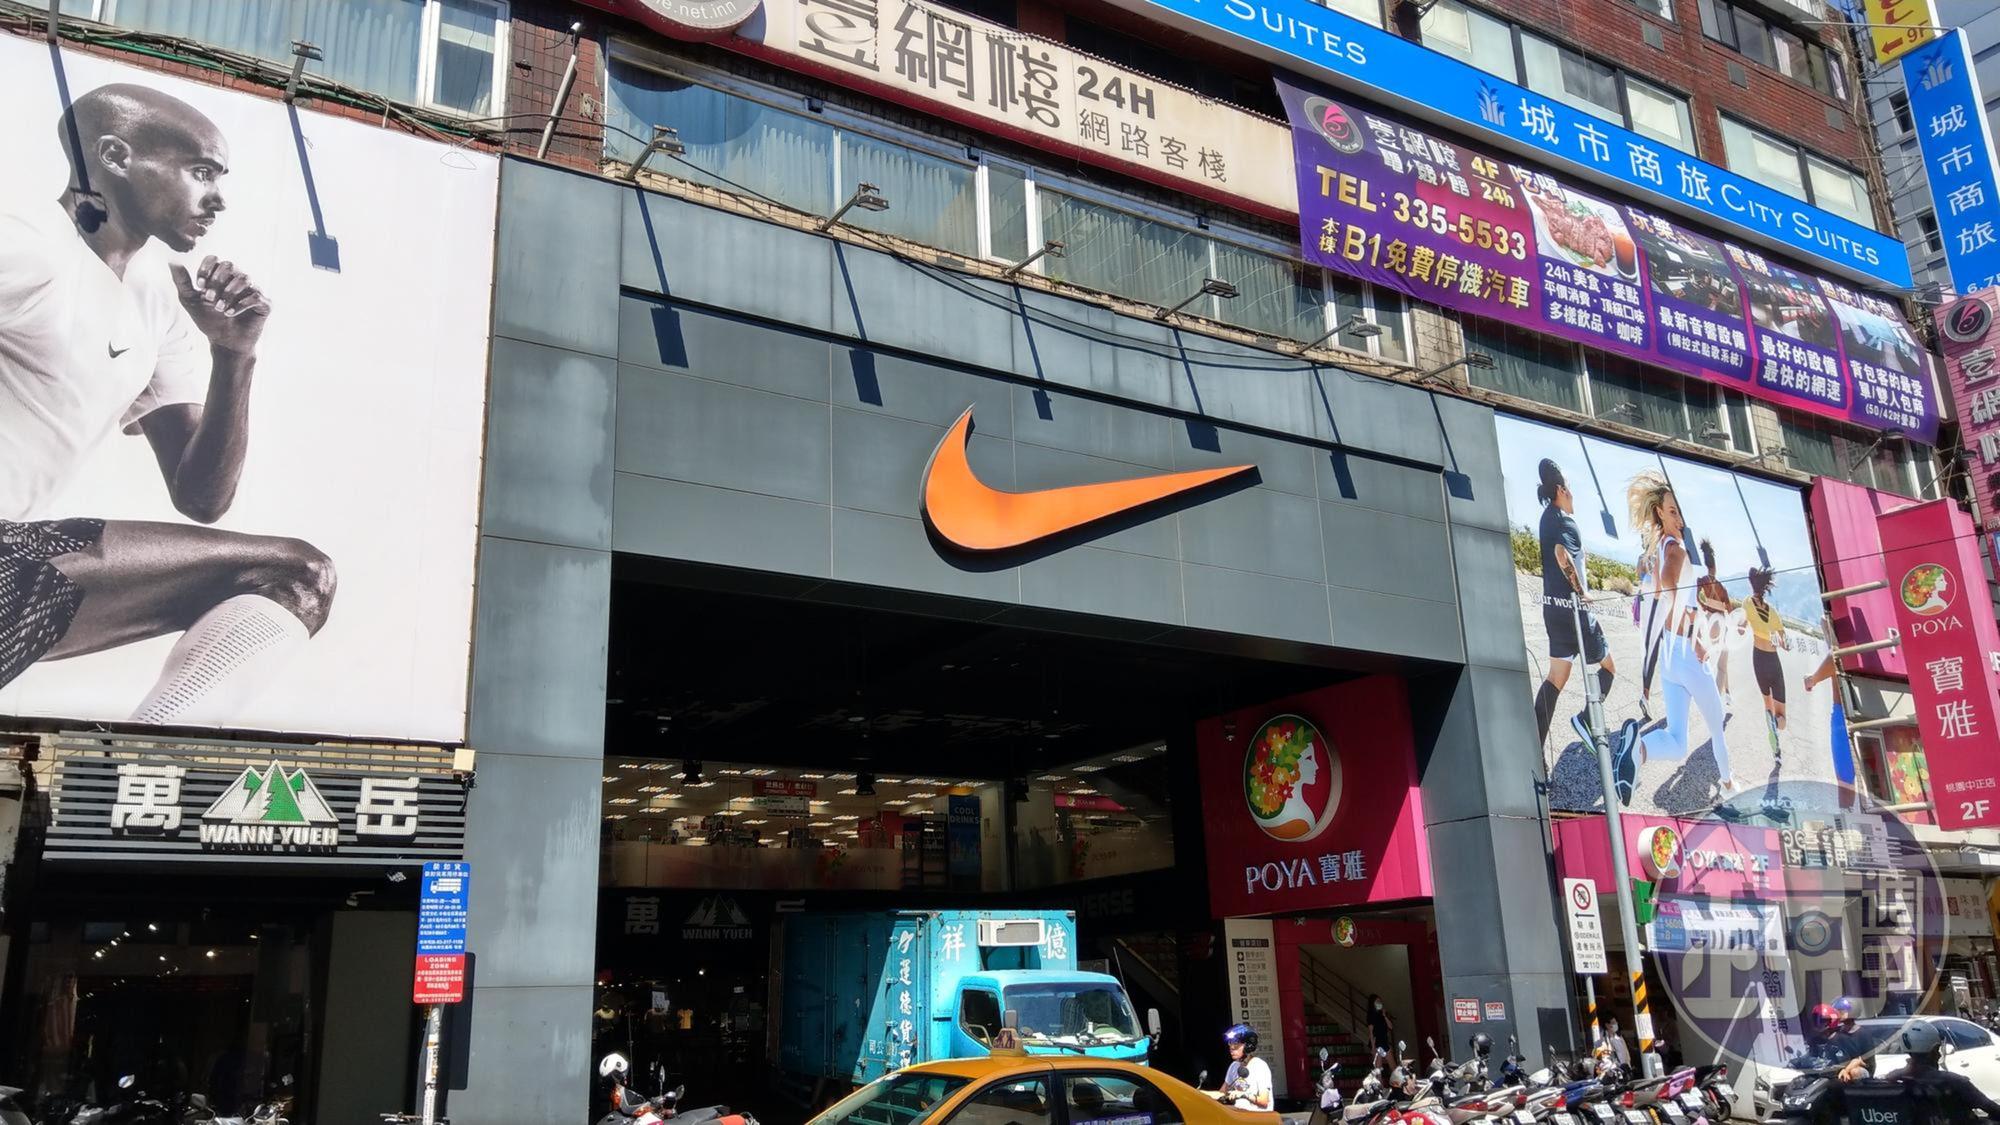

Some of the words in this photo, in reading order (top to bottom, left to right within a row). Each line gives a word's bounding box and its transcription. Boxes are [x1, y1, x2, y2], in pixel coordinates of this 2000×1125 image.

[1078, 66, 1155, 119] 24H
[1078, 108, 1227, 183] 網路客棧
[1471, 156, 1500, 179] 4F
[1519, 98, 1713, 205] 城市商旅
[1721, 184, 1783, 230] CITY
[1792, 211, 1880, 266] SUITES
[1929, 104, 1997, 255] 城市商旅
[1481, 182, 1515, 208] 24h
[1393, 193, 1526, 260] 335-5533
[1911, 615, 1963, 637] POYA
[1925, 656, 1979, 739] 寶雅
[111, 764, 185, 830] 萬
[355, 777, 420, 836] 岳
[953, 806, 976, 816] COOL
[1960, 800, 1990, 820] 2F
[200, 824, 274, 845] WANN
[280, 824, 338, 847] YUEH
[1246, 858, 1317, 894] POYA
[1319, 850, 1367, 881] 寶雅
[941, 924, 965, 961] 祥
[1045, 924, 1067, 960] 億
[1861, 1108, 1899, 1123] Uber
